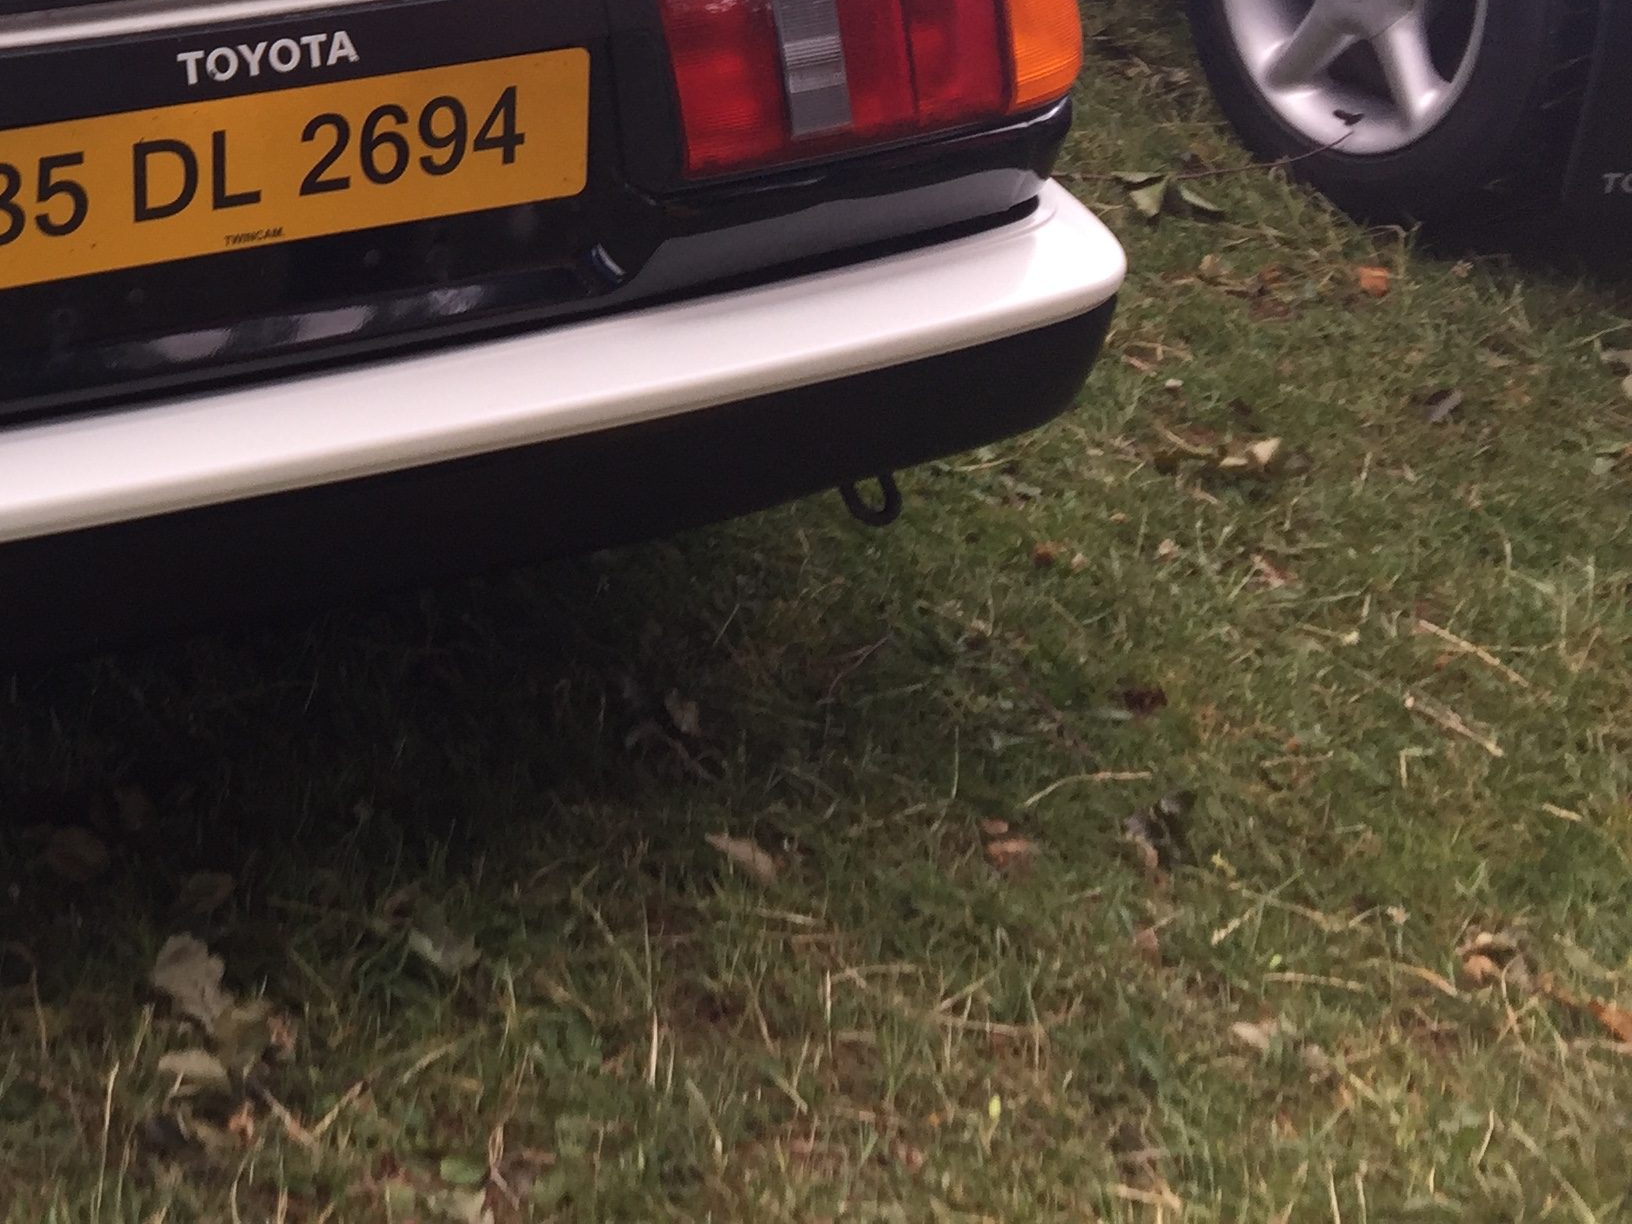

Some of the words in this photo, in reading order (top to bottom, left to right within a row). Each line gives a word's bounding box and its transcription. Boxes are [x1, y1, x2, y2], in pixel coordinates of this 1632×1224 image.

[176, 30, 360, 87] TOYOTA
[132, 129, 263, 223] DL
[298, 85, 526, 197] 2694
